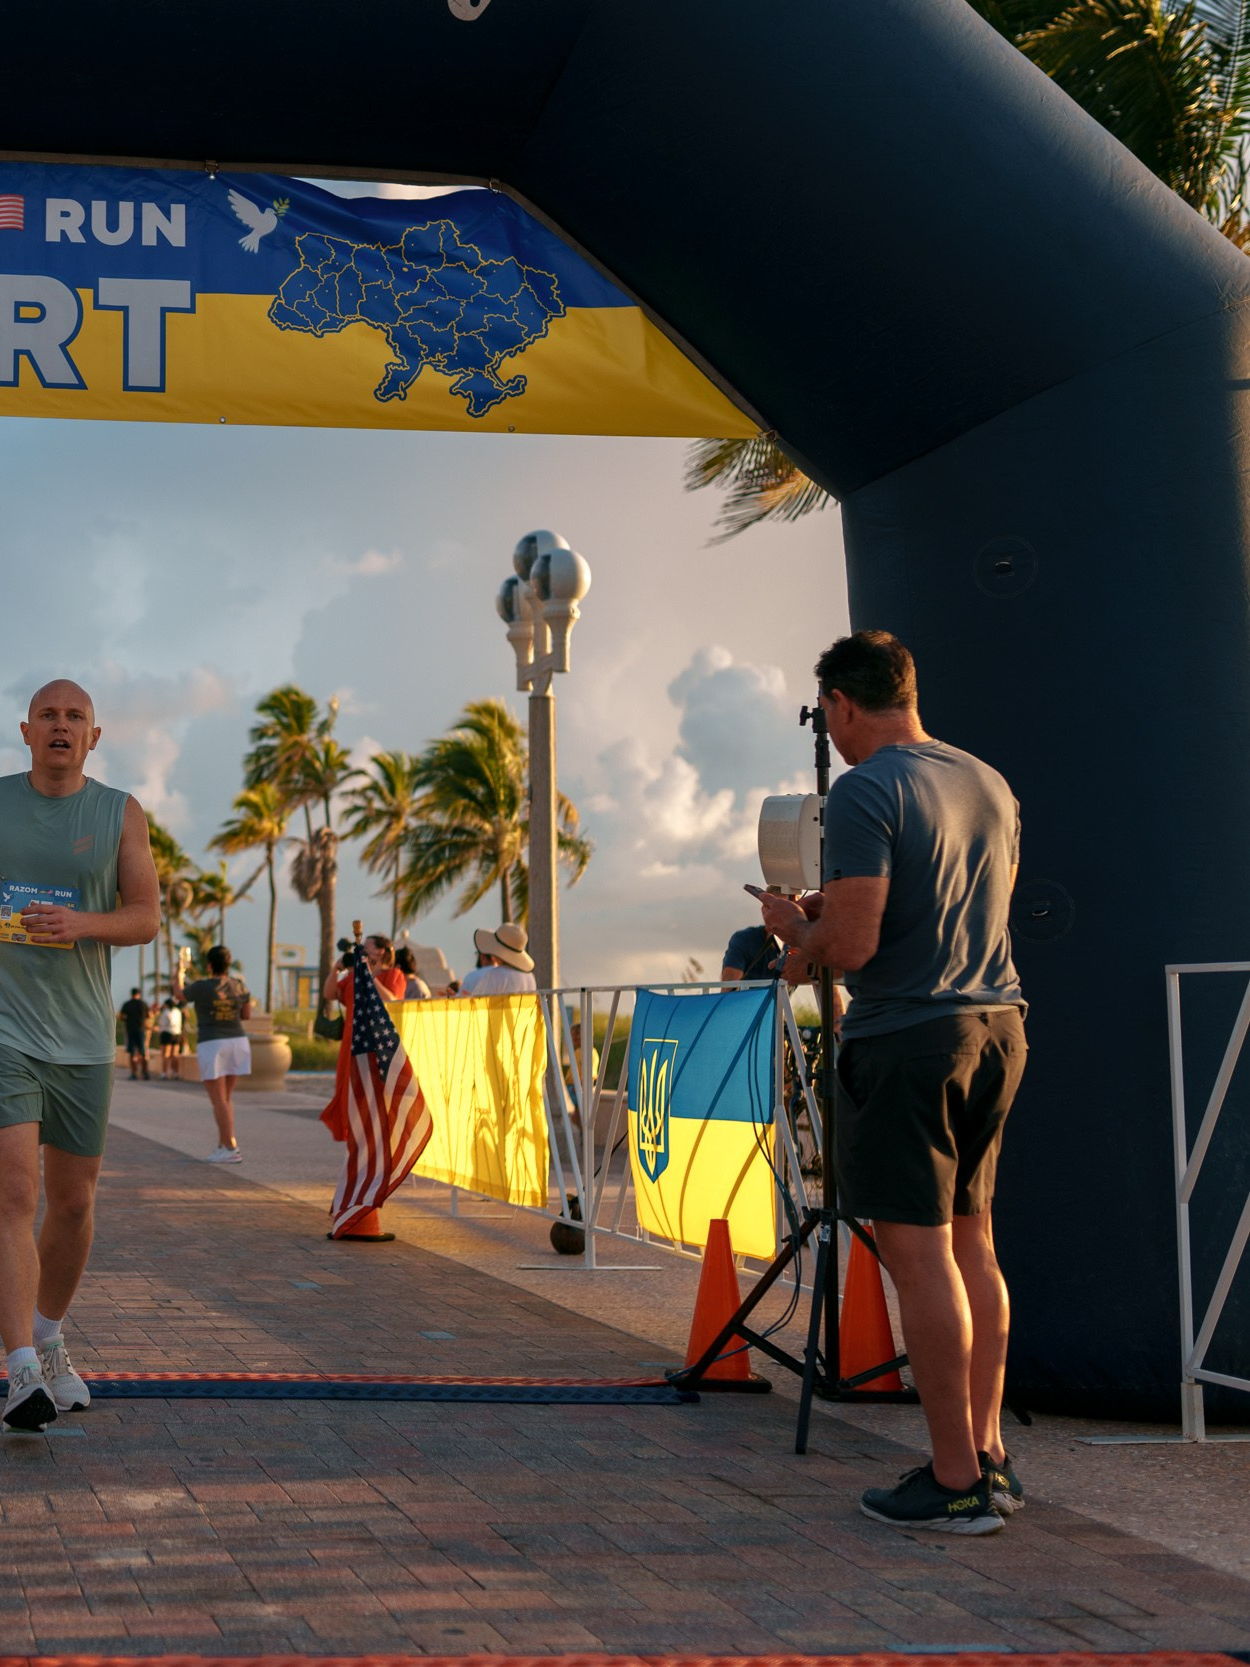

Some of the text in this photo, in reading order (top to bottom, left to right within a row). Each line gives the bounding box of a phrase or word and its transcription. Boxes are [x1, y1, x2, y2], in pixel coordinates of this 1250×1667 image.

[45, 197, 186, 248] RUN
[9, 885, 72, 898] RAZOM RUN
[948, 1496, 980, 1513] HOKA
